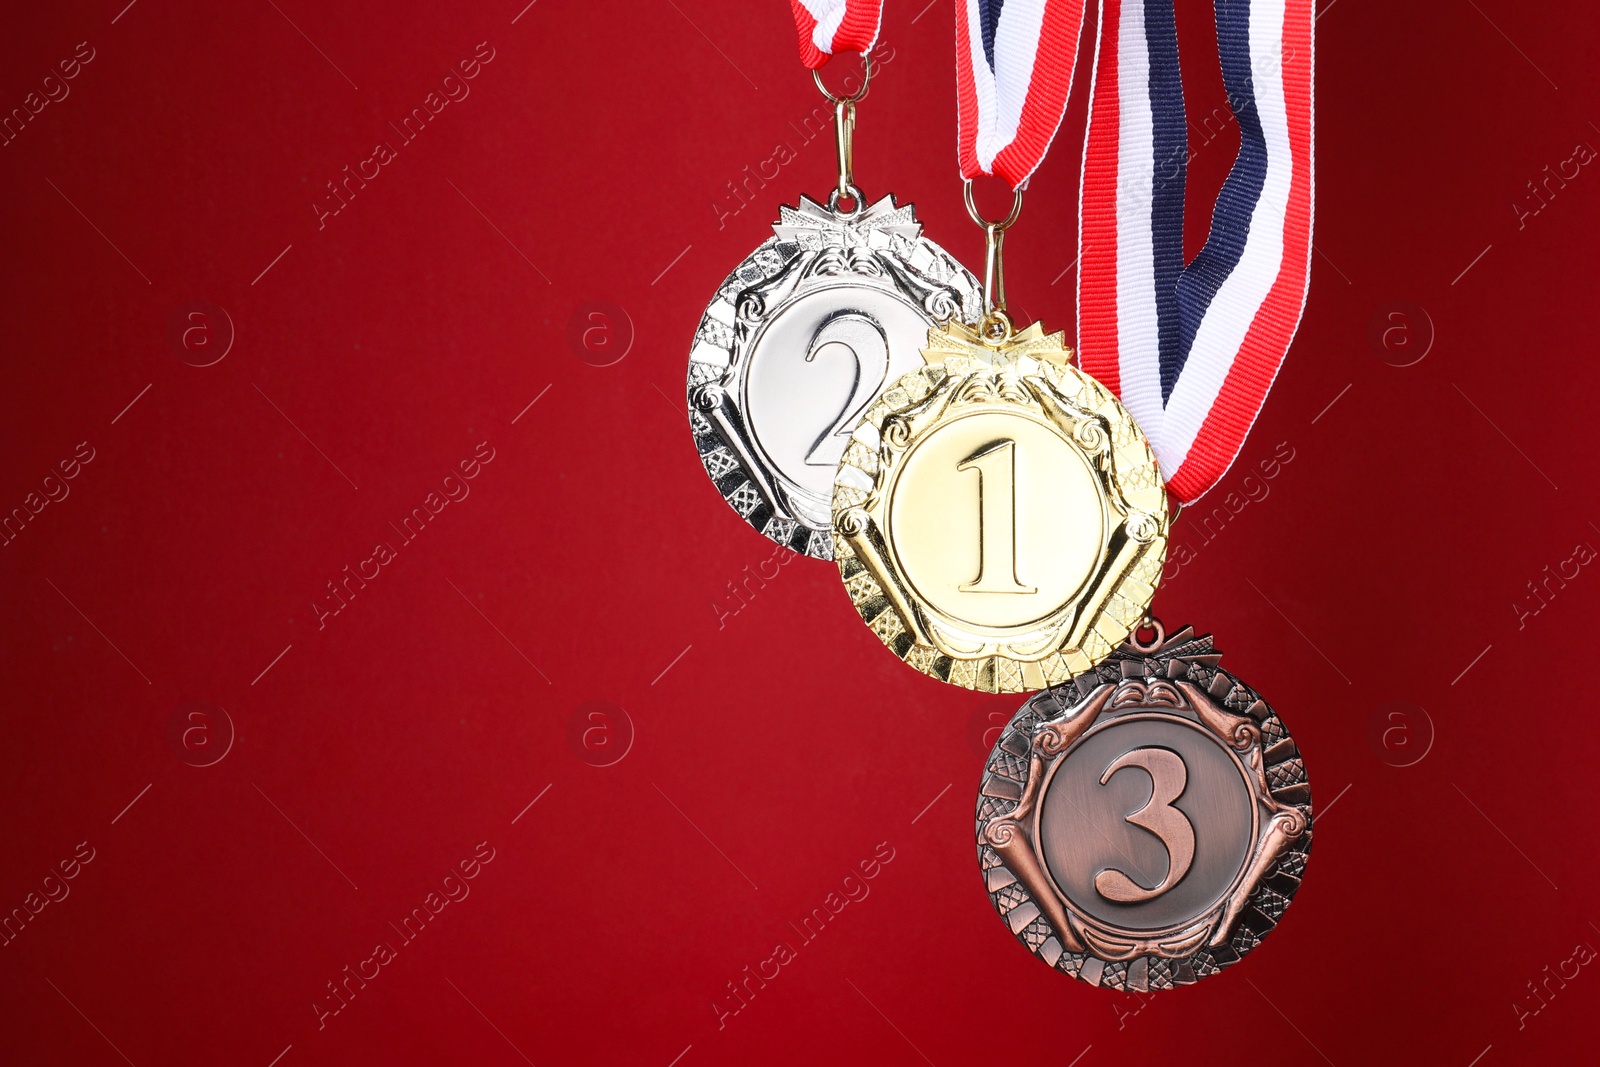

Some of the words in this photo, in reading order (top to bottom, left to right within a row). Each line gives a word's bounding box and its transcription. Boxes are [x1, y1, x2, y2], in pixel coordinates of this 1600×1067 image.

[805, 309, 889, 467] 2
[956, 438, 1038, 595] 1
[1093, 745, 1196, 905] 3
